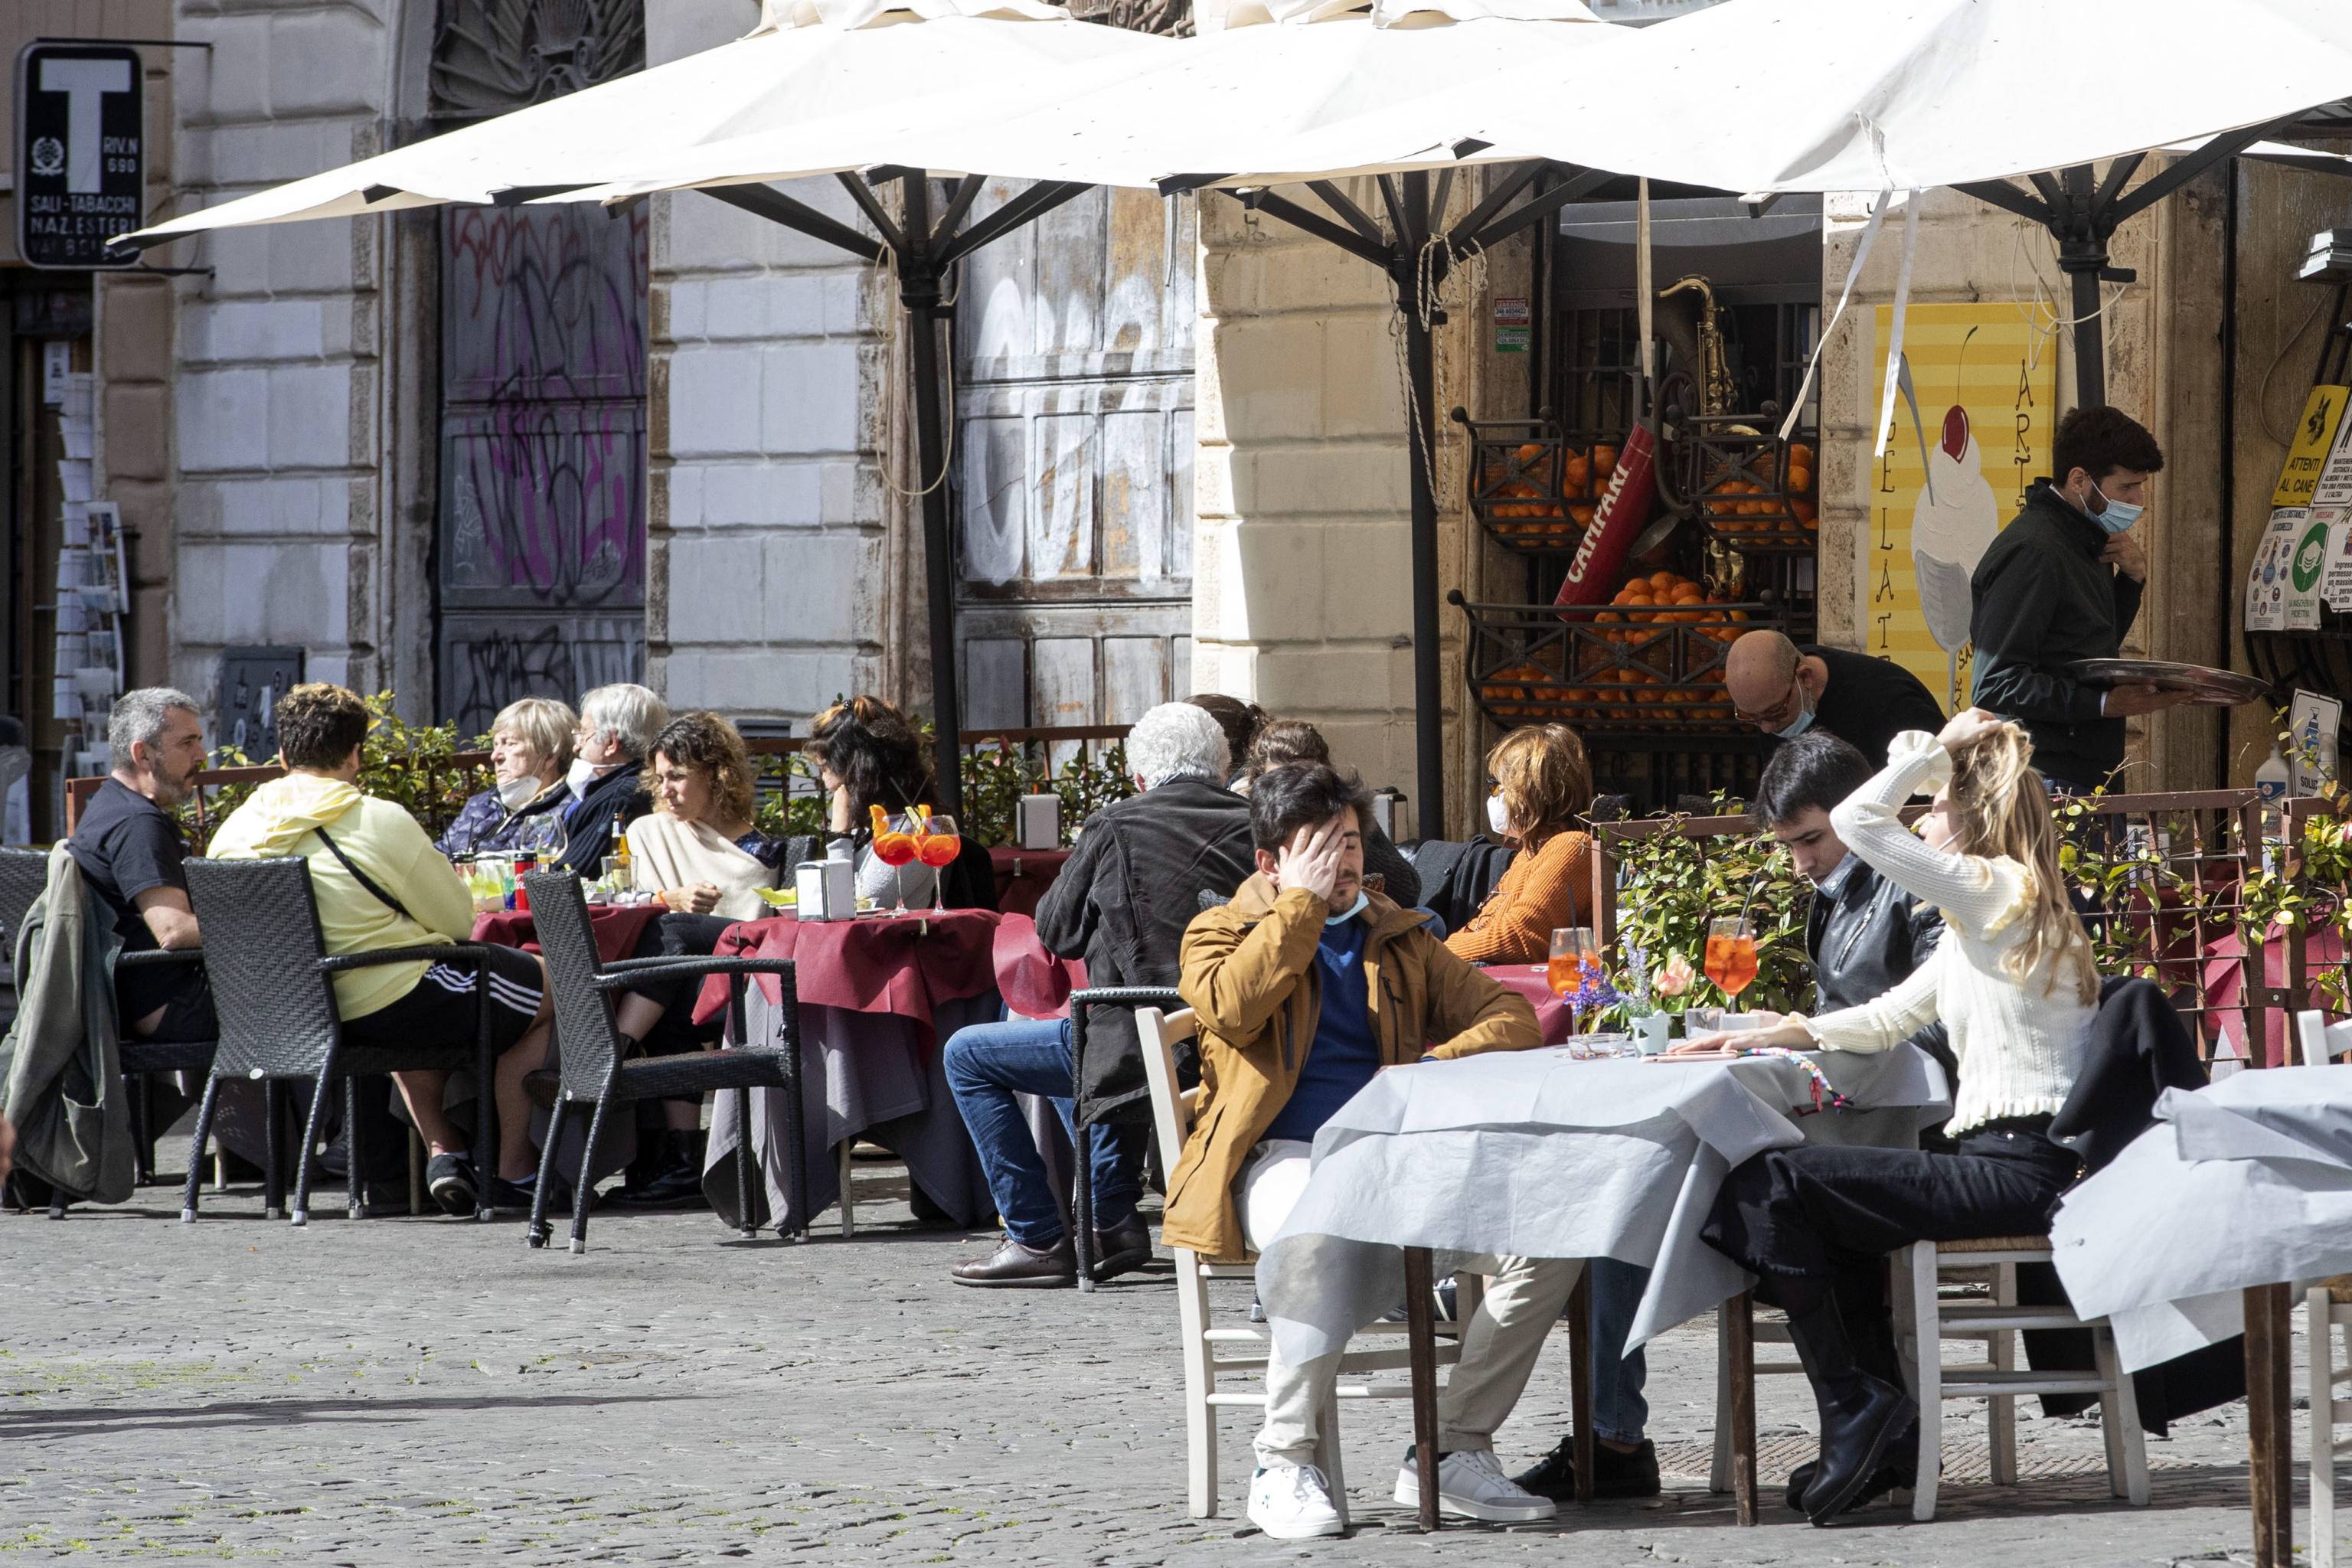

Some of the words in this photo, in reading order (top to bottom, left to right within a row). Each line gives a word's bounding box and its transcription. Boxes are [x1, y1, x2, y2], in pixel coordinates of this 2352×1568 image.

[41, 59, 132, 193] T
[2278, 479, 2291, 492] AL
[2293, 479, 2314, 492] CANE
[2288, 457, 2321, 471] ATTENTI
[1568, 463, 1630, 583] CAMPARI
